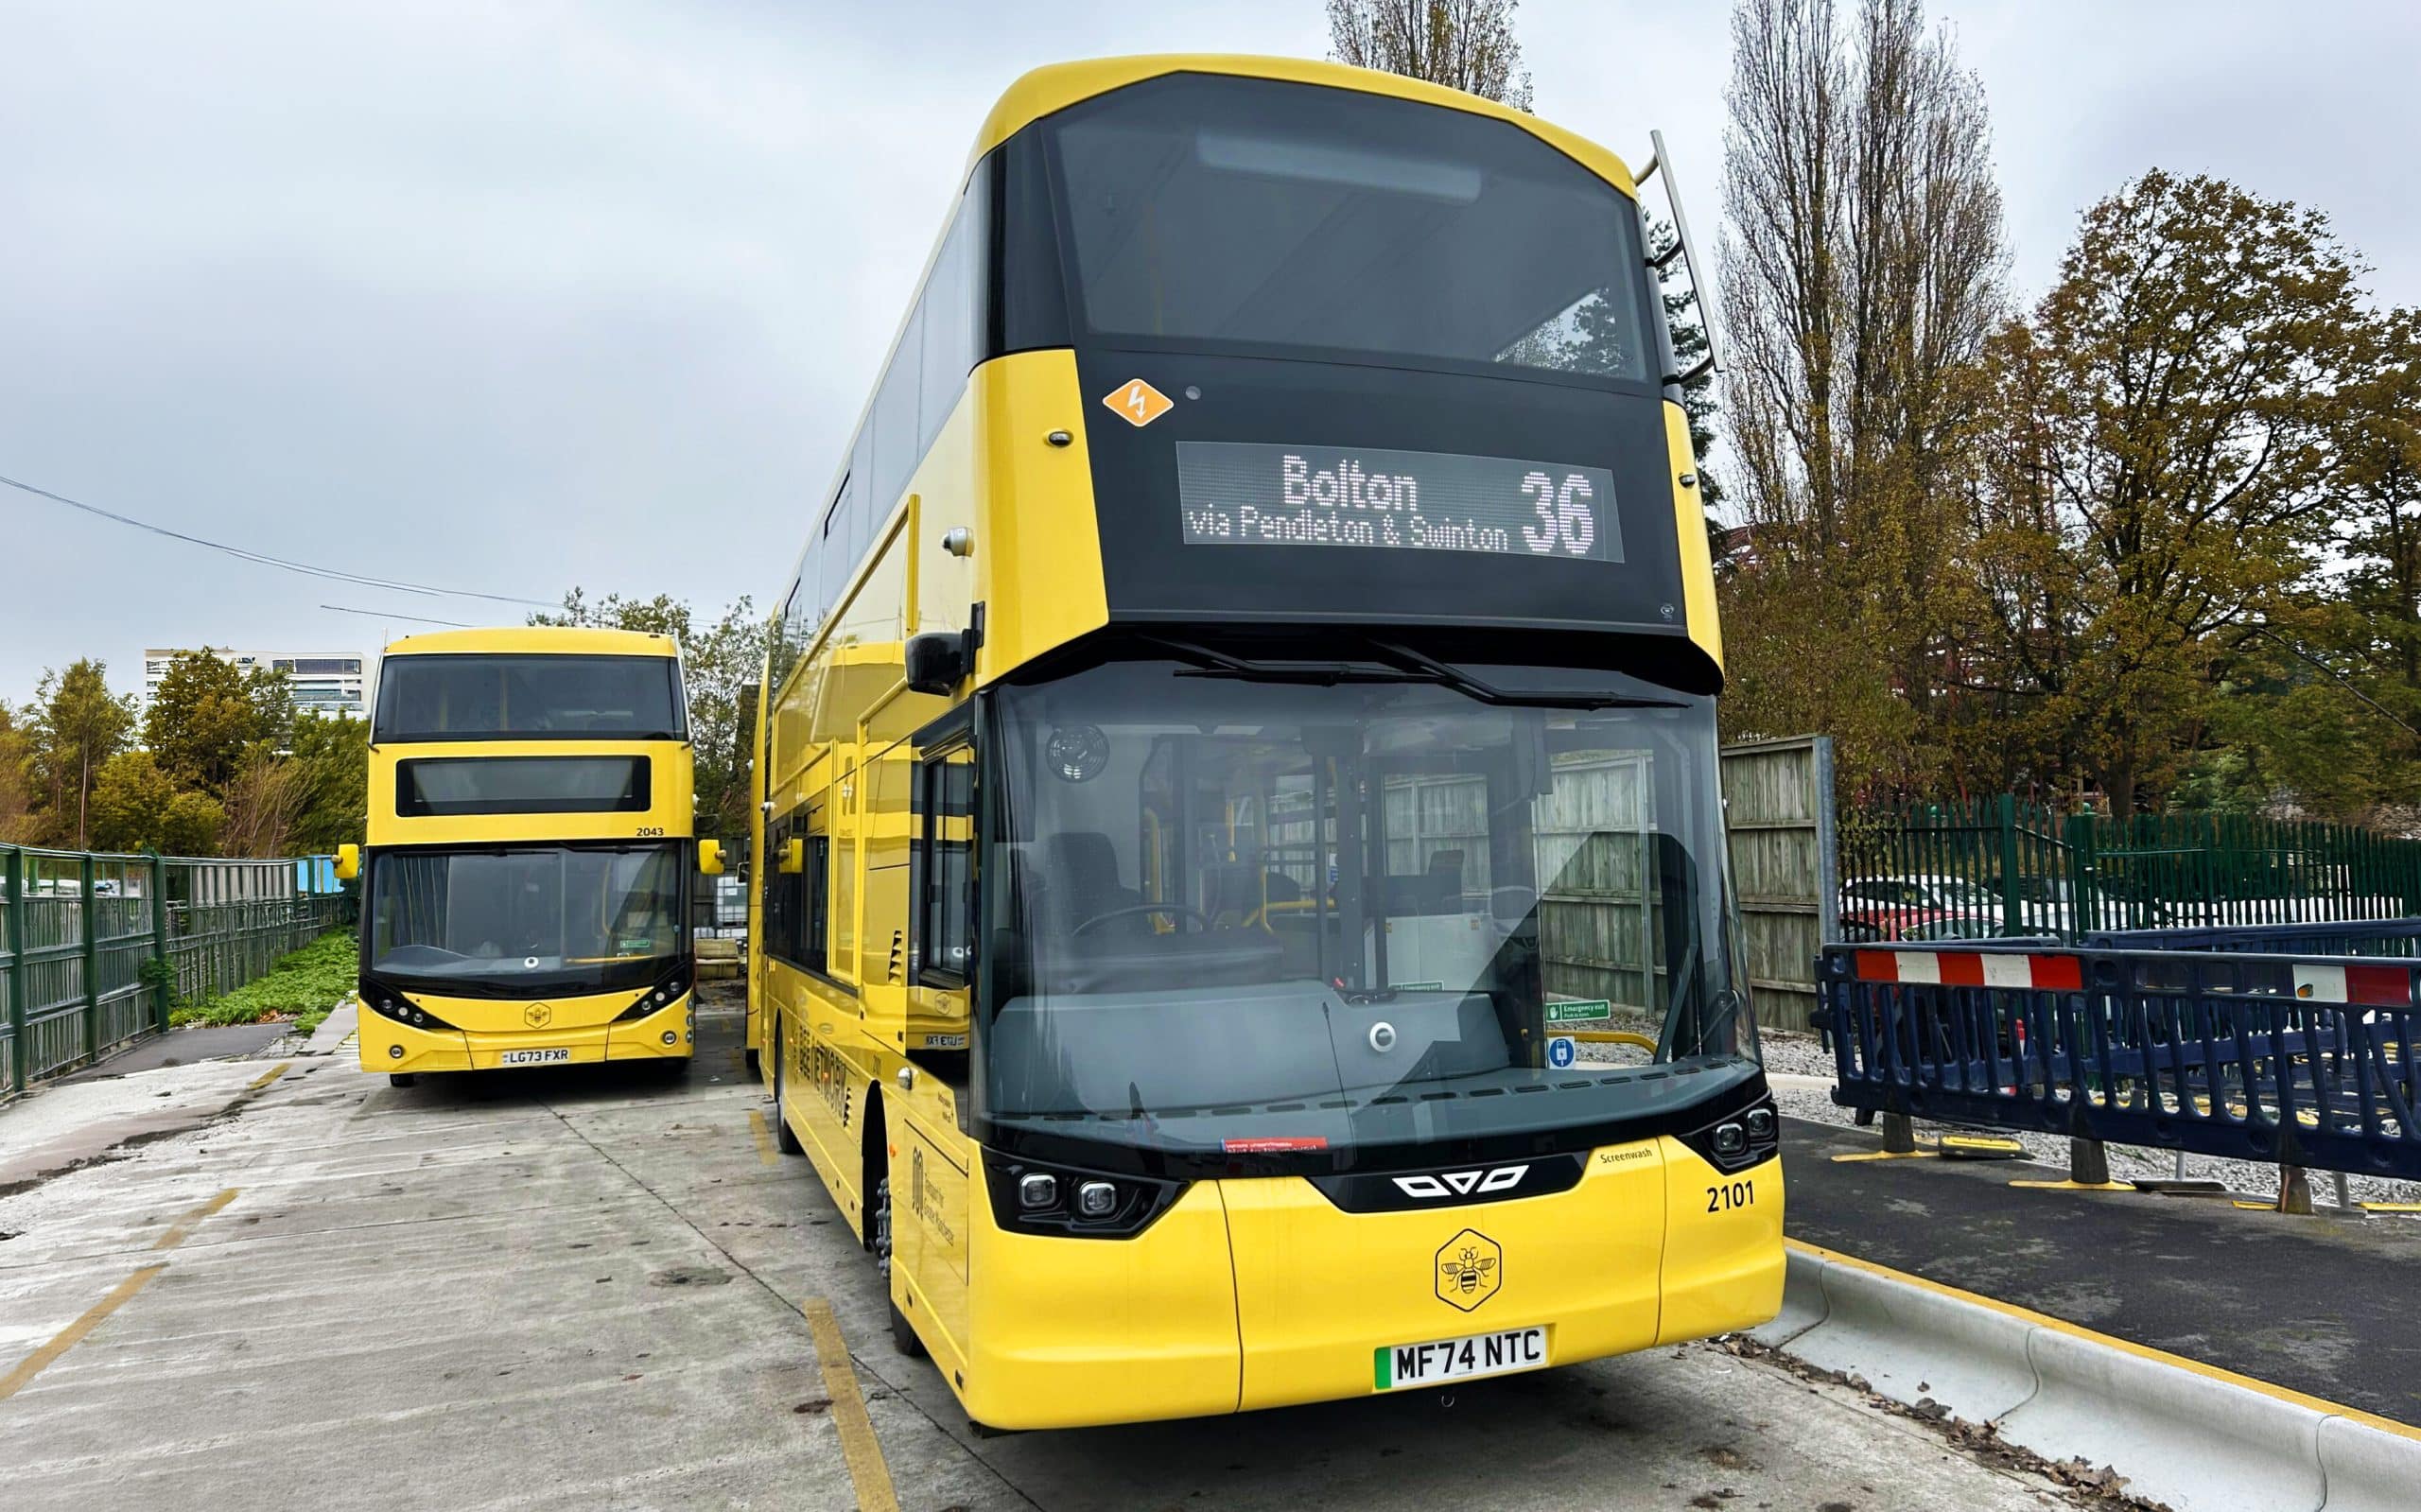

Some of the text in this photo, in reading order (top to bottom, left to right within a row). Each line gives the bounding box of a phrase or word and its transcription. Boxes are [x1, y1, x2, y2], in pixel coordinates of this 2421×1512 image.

[1282, 454, 1418, 512] Bolton
[1189, 503, 1508, 551] via Pendleton & Swinton
[1521, 471, 1595, 554] 36
[636, 827, 664, 837] 2043
[510, 1050, 568, 1063] LG73 FXR
[1600, 1147, 1653, 1164] Screenwash
[1707, 1179, 1753, 1213] 2101
[1397, 1330, 1541, 1380] MF74 NTC
